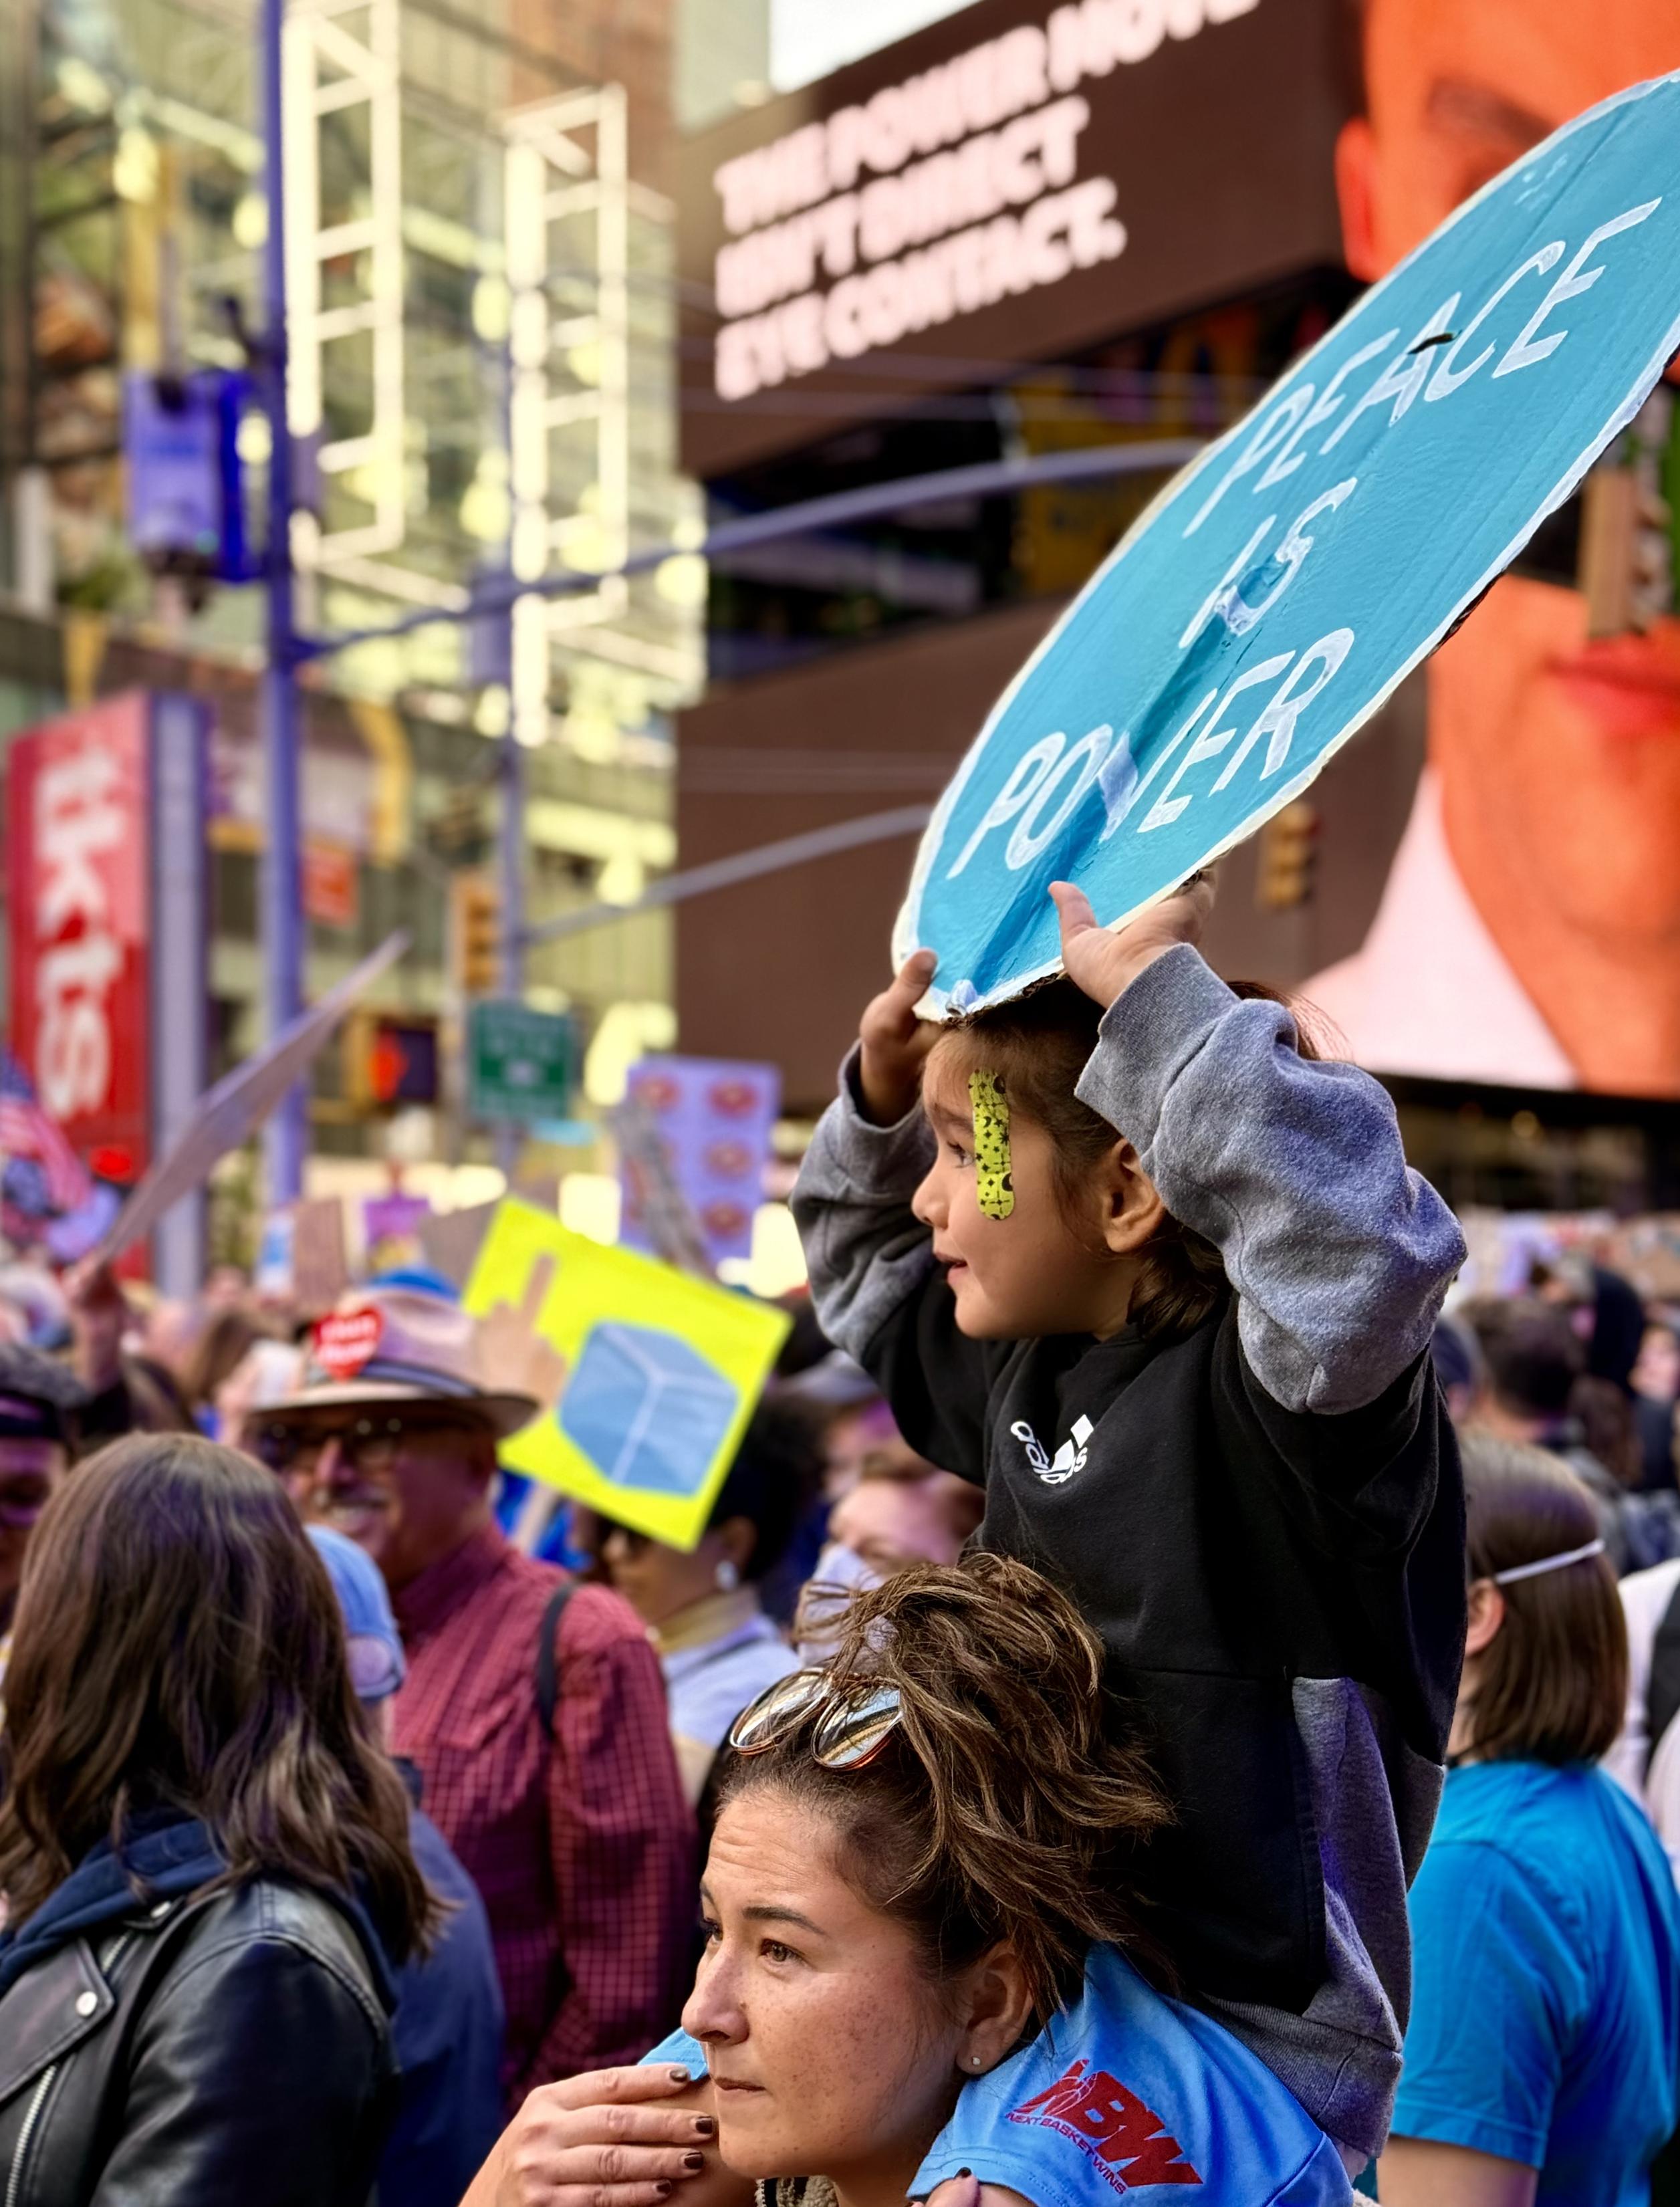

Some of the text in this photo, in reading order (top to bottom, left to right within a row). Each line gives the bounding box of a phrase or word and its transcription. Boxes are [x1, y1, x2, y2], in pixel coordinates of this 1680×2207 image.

[1183, 197, 1663, 538] PEACE
[1179, 477, 1358, 649] IS
[946, 627, 1355, 880] POWER
[1005, 2111, 1127, 2196] NEXT BASKET WINS
